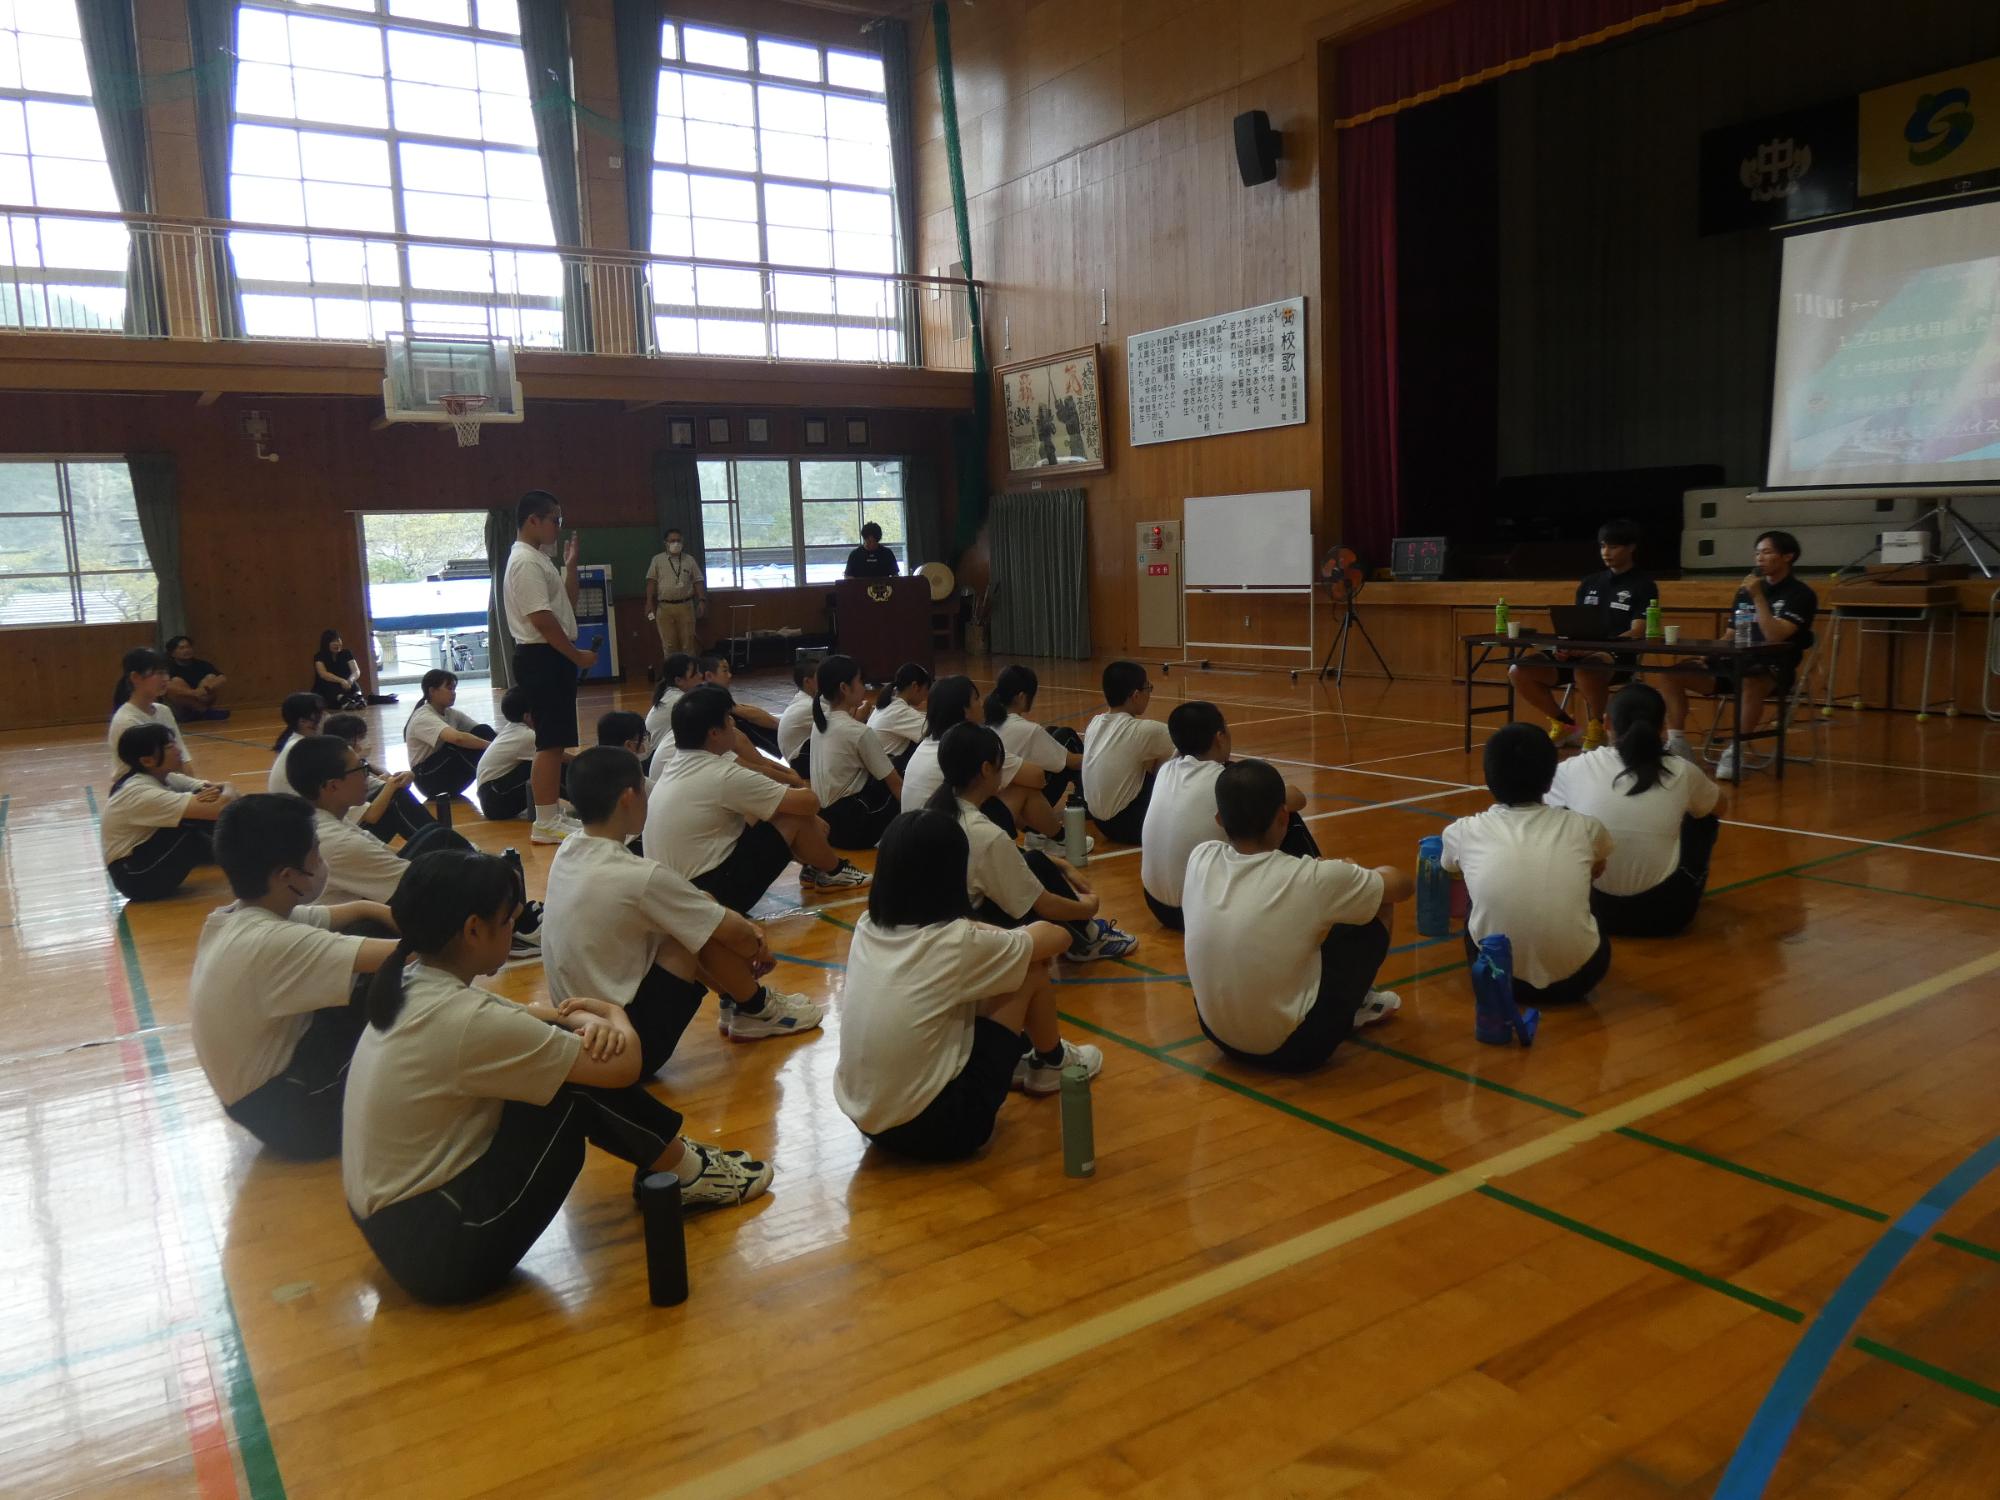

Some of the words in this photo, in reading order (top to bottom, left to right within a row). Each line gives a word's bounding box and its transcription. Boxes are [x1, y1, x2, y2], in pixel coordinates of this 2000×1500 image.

[1222, 318, 1228, 329] 2
[1174, 329, 1179, 340] 3
[1281, 330, 1295, 373] 校歌
